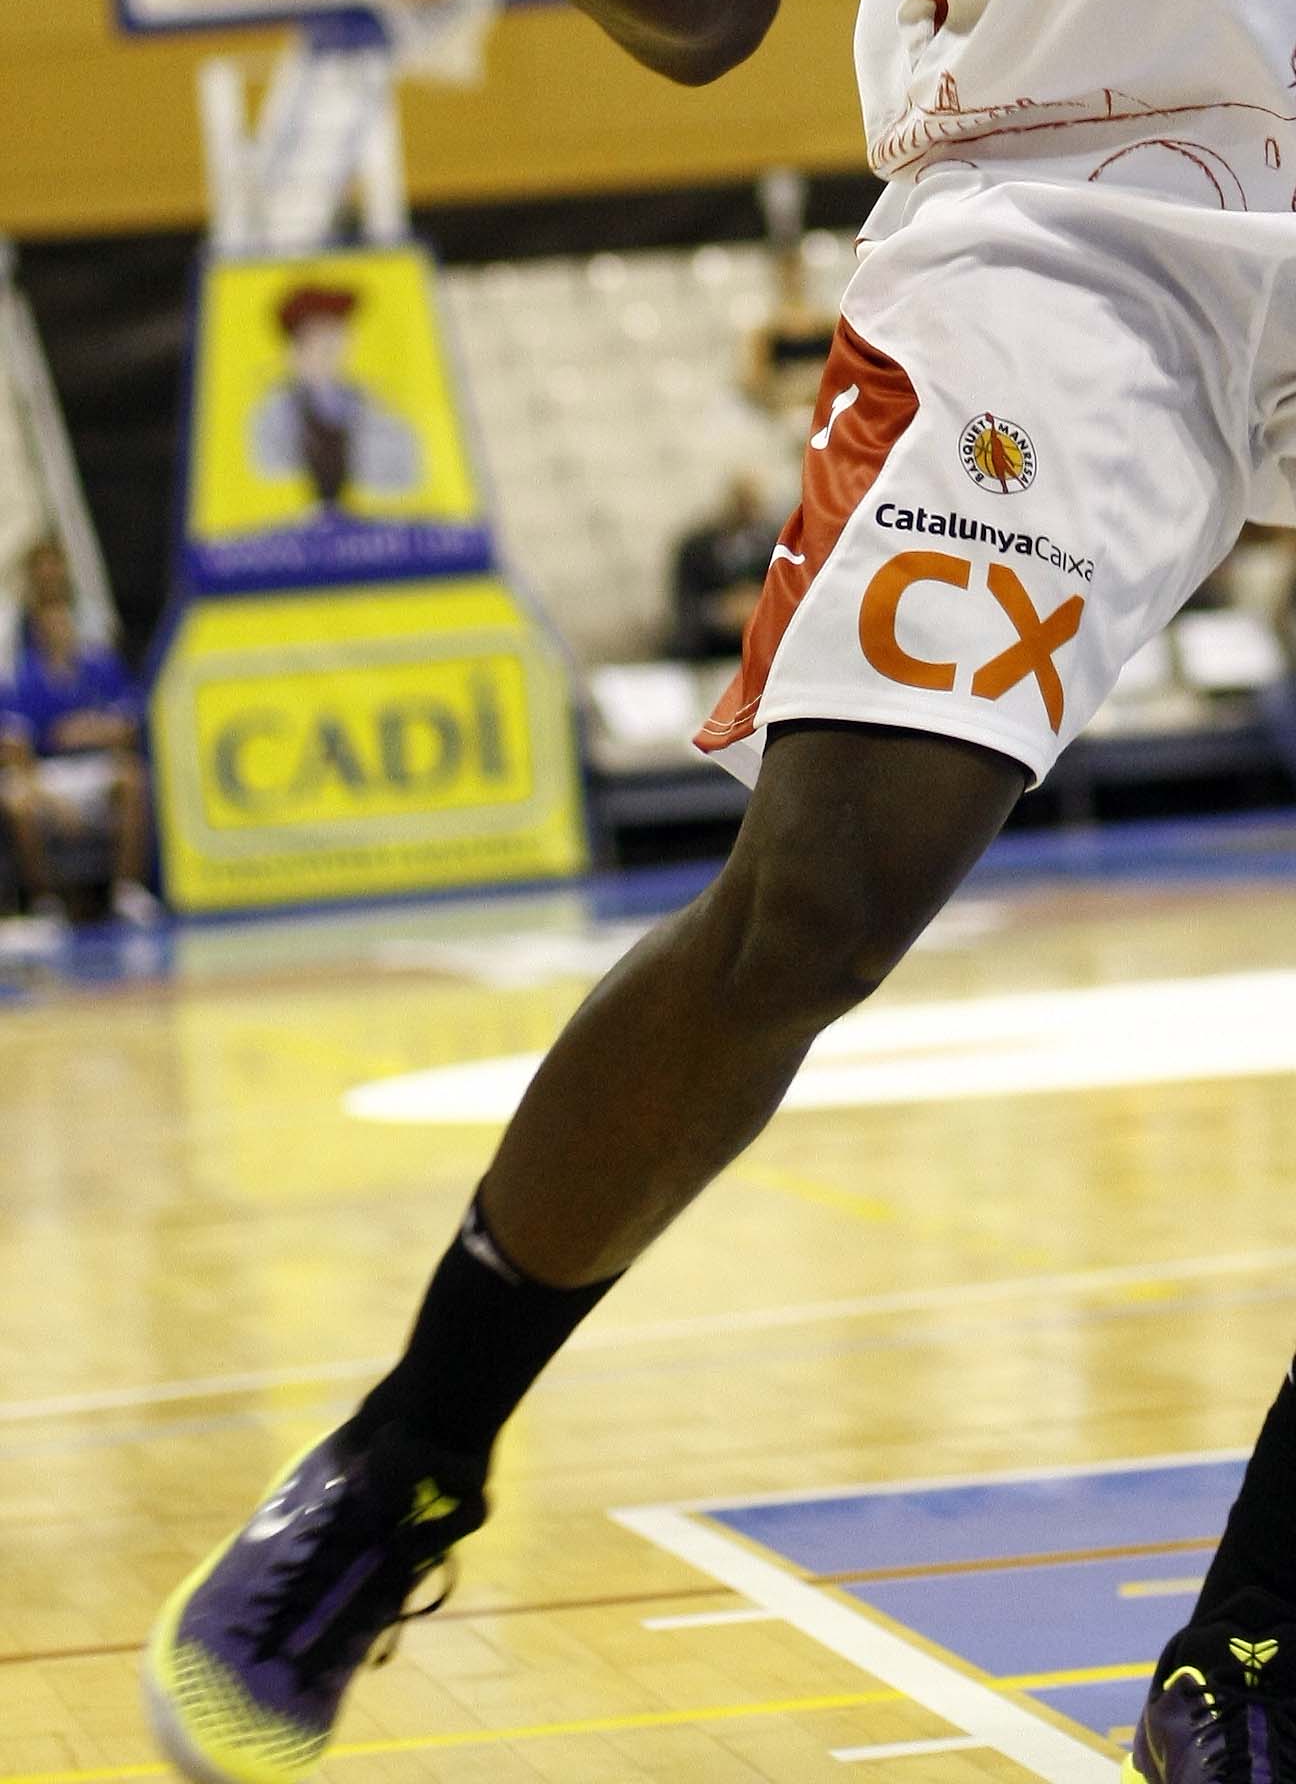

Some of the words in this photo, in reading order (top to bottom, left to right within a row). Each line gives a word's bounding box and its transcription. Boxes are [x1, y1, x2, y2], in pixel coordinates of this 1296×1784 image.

[962, 419, 986, 483] BASQUET
[998, 422, 1034, 484] MANRESA
[857, 550, 1086, 737] CX
